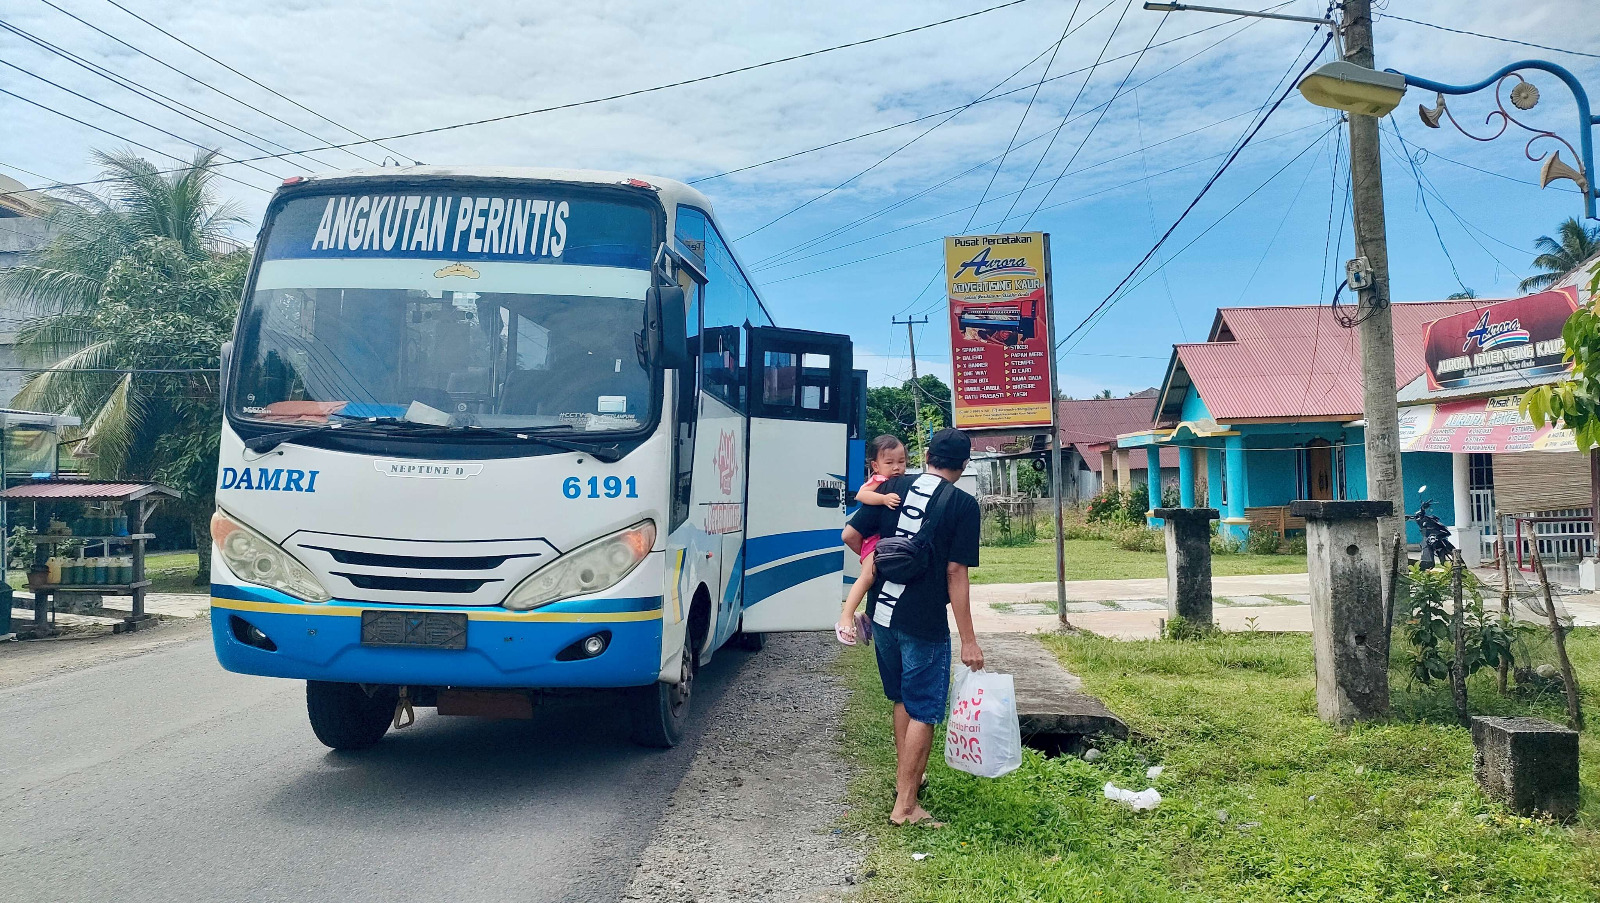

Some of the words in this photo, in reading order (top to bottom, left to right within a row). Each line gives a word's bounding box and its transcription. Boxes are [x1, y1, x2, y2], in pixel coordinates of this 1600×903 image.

[311, 195, 452, 251] ANGKUTAN
[452, 197, 570, 257] PERINTIS
[954, 238, 979, 247] Pusat
[982, 236, 1032, 246] Percetakan
[954, 247, 1027, 278] Aurora
[952, 280, 1012, 294] ADVERTISING
[1014, 279, 1040, 291] KAUR
[1462, 309, 1521, 352] Aurora
[1437, 355, 1473, 375] AURORA
[1473, 343, 1535, 368] ADVERTISING
[1488, 396, 1511, 408] Pusat
[220, 467, 320, 493] DAMRI
[390, 465, 450, 475] NEPTUNE
[455, 467, 464, 475] D
[562, 475, 639, 499] 6191
